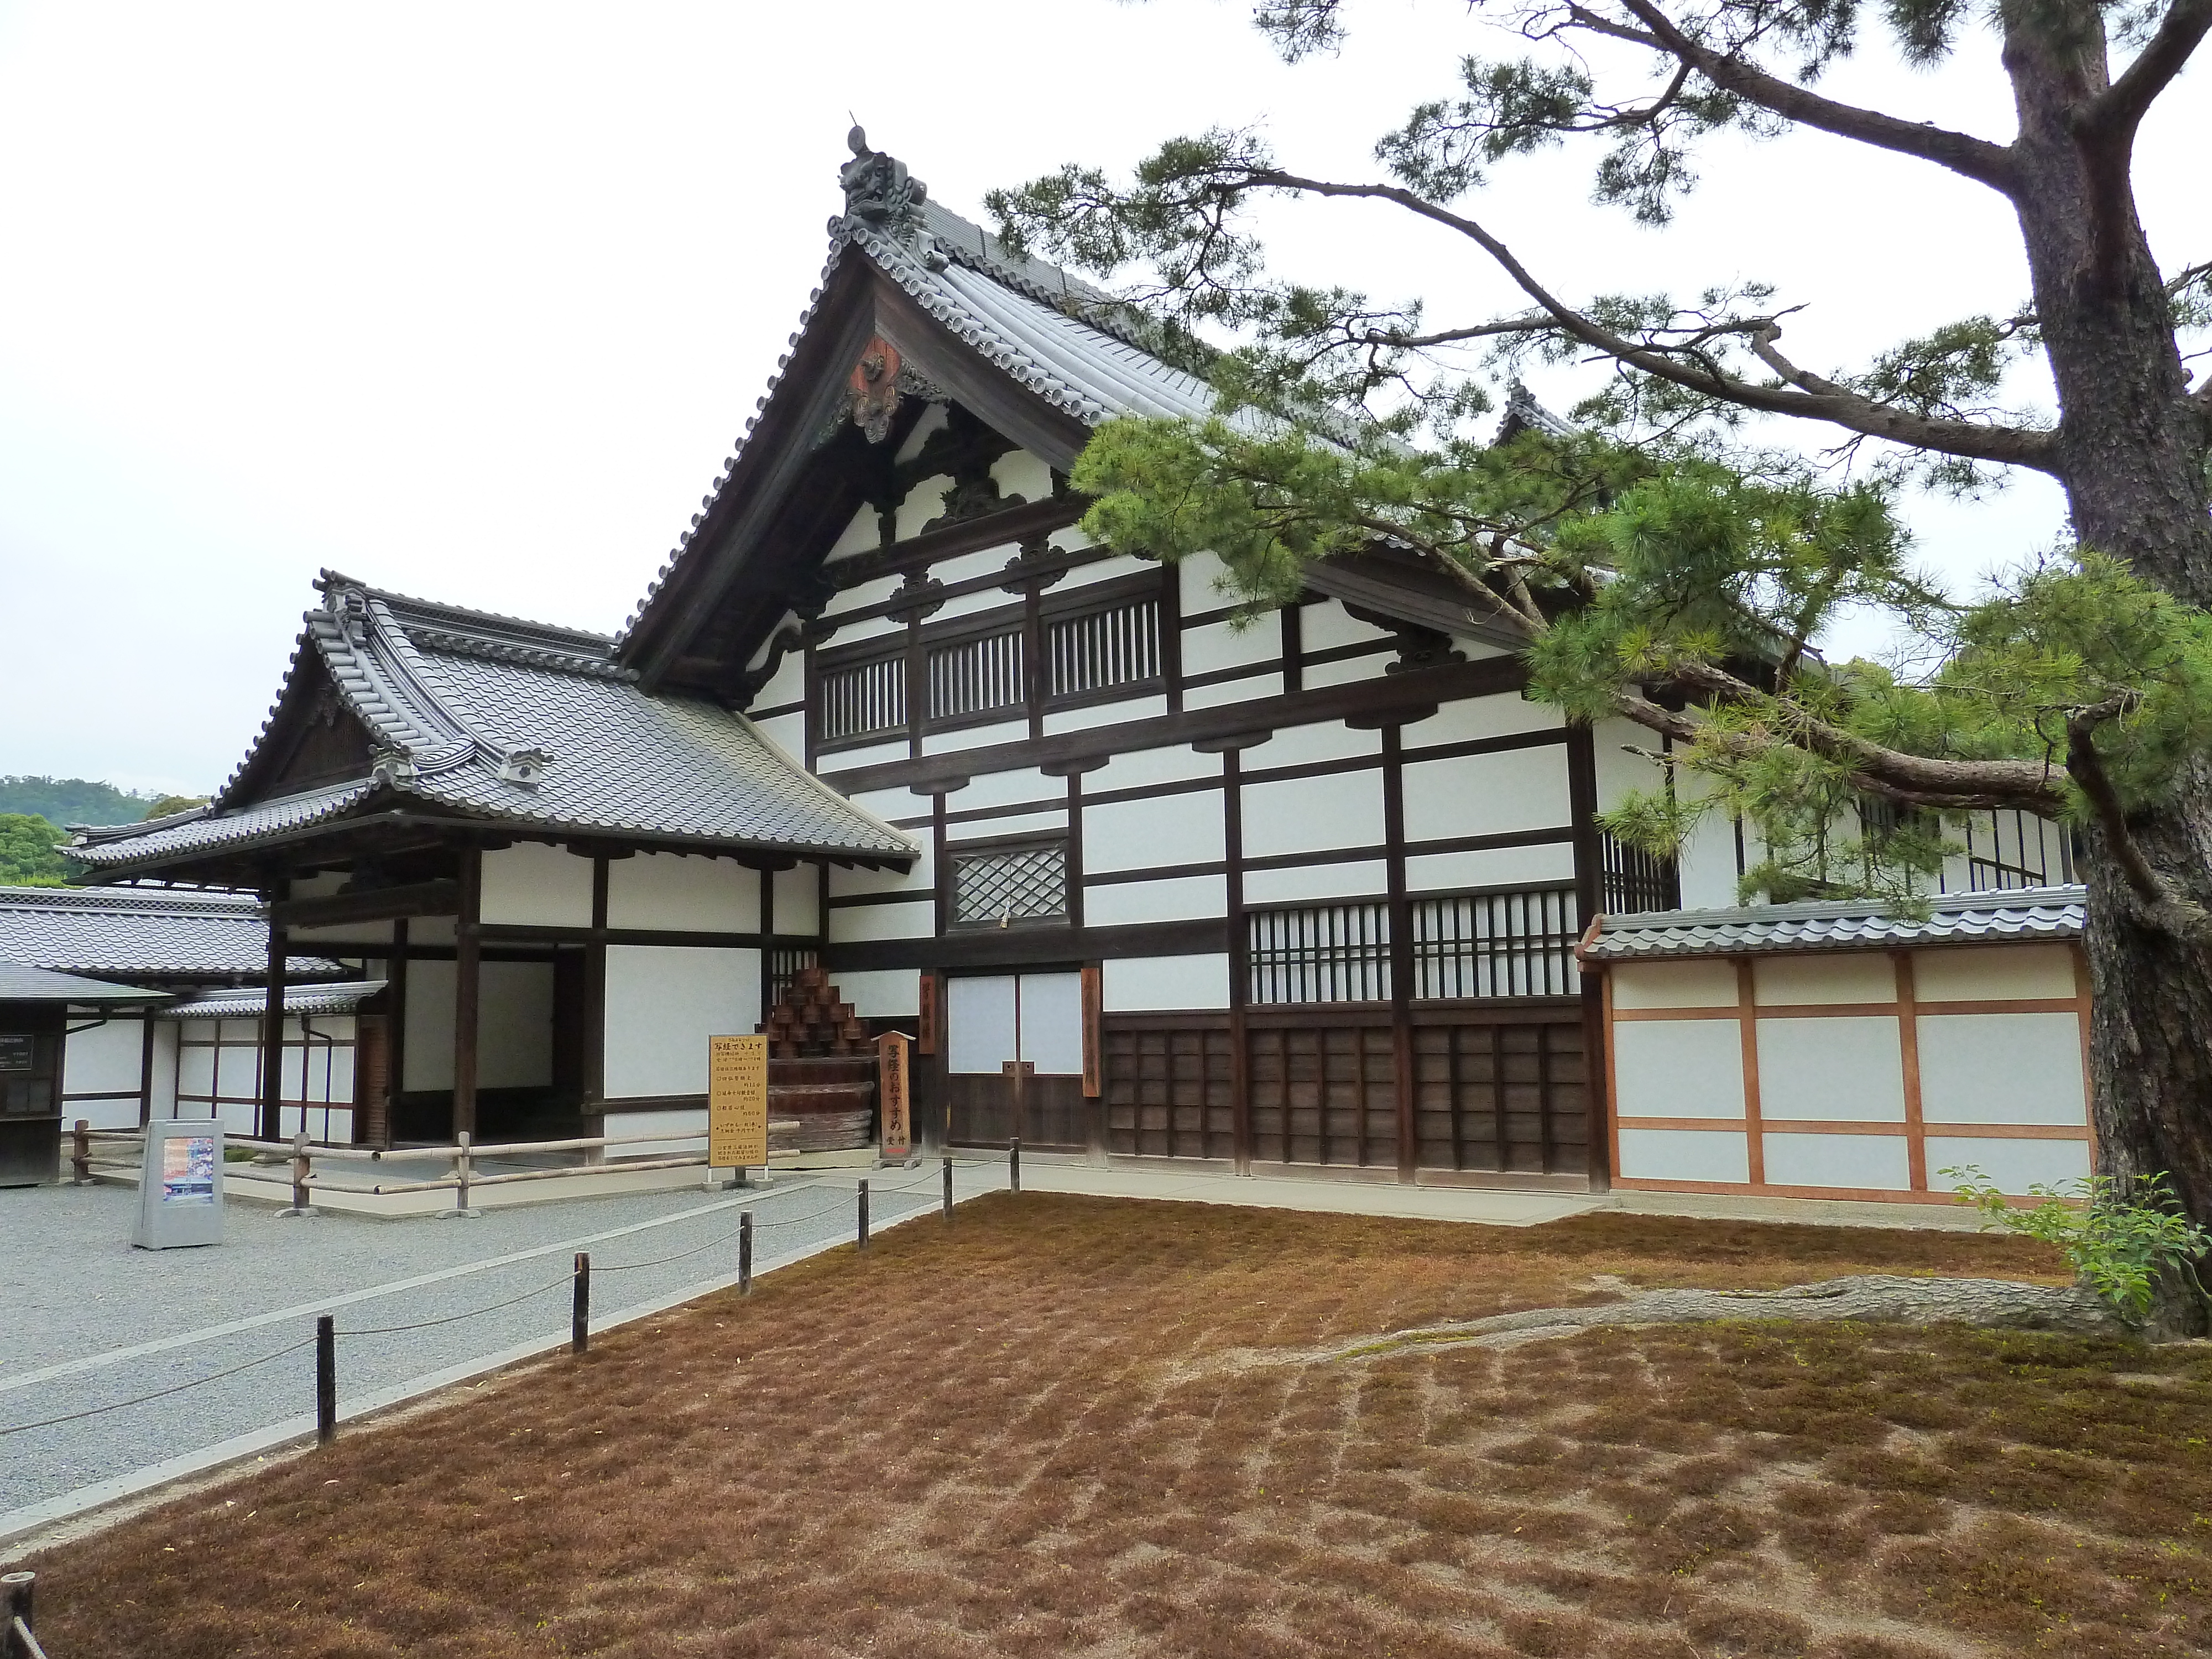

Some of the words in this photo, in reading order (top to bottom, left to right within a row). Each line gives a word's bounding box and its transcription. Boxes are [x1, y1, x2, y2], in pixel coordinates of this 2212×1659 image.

[714, 1042, 762, 1051] 写経できます
